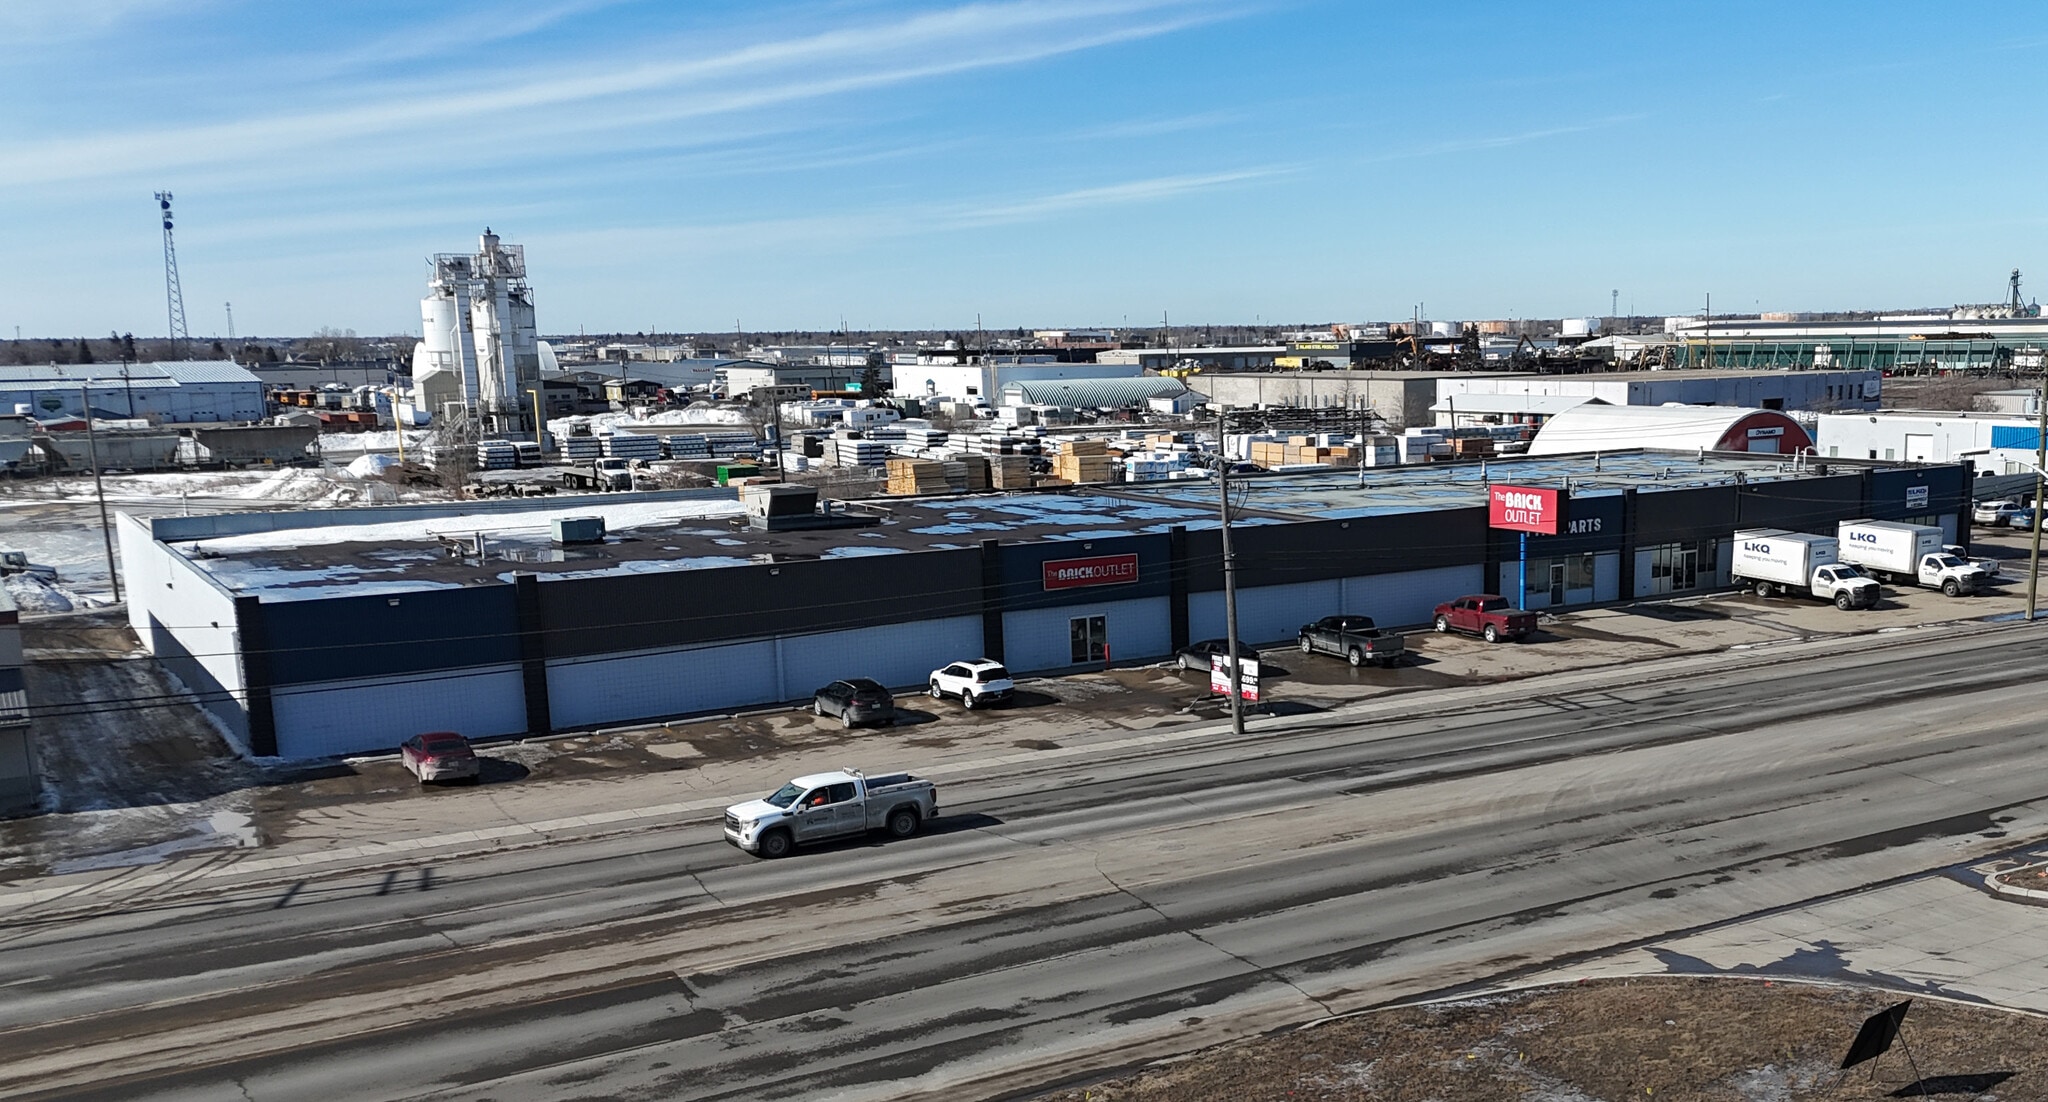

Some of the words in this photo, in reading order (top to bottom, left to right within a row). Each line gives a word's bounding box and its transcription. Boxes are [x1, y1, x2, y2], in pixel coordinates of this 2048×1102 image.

[1494, 491, 1506, 502] The
[1505, 491, 1543, 511] BRICK
[1504, 508, 1541, 525] OUTLET
[1568, 518, 1602, 535] ARTS
[1850, 531, 1877, 544] LKQ
[1744, 541, 1771, 555] LKQ
[1058, 567, 1093, 581] BRICK
[1093, 562, 1135, 578] OUTLET
